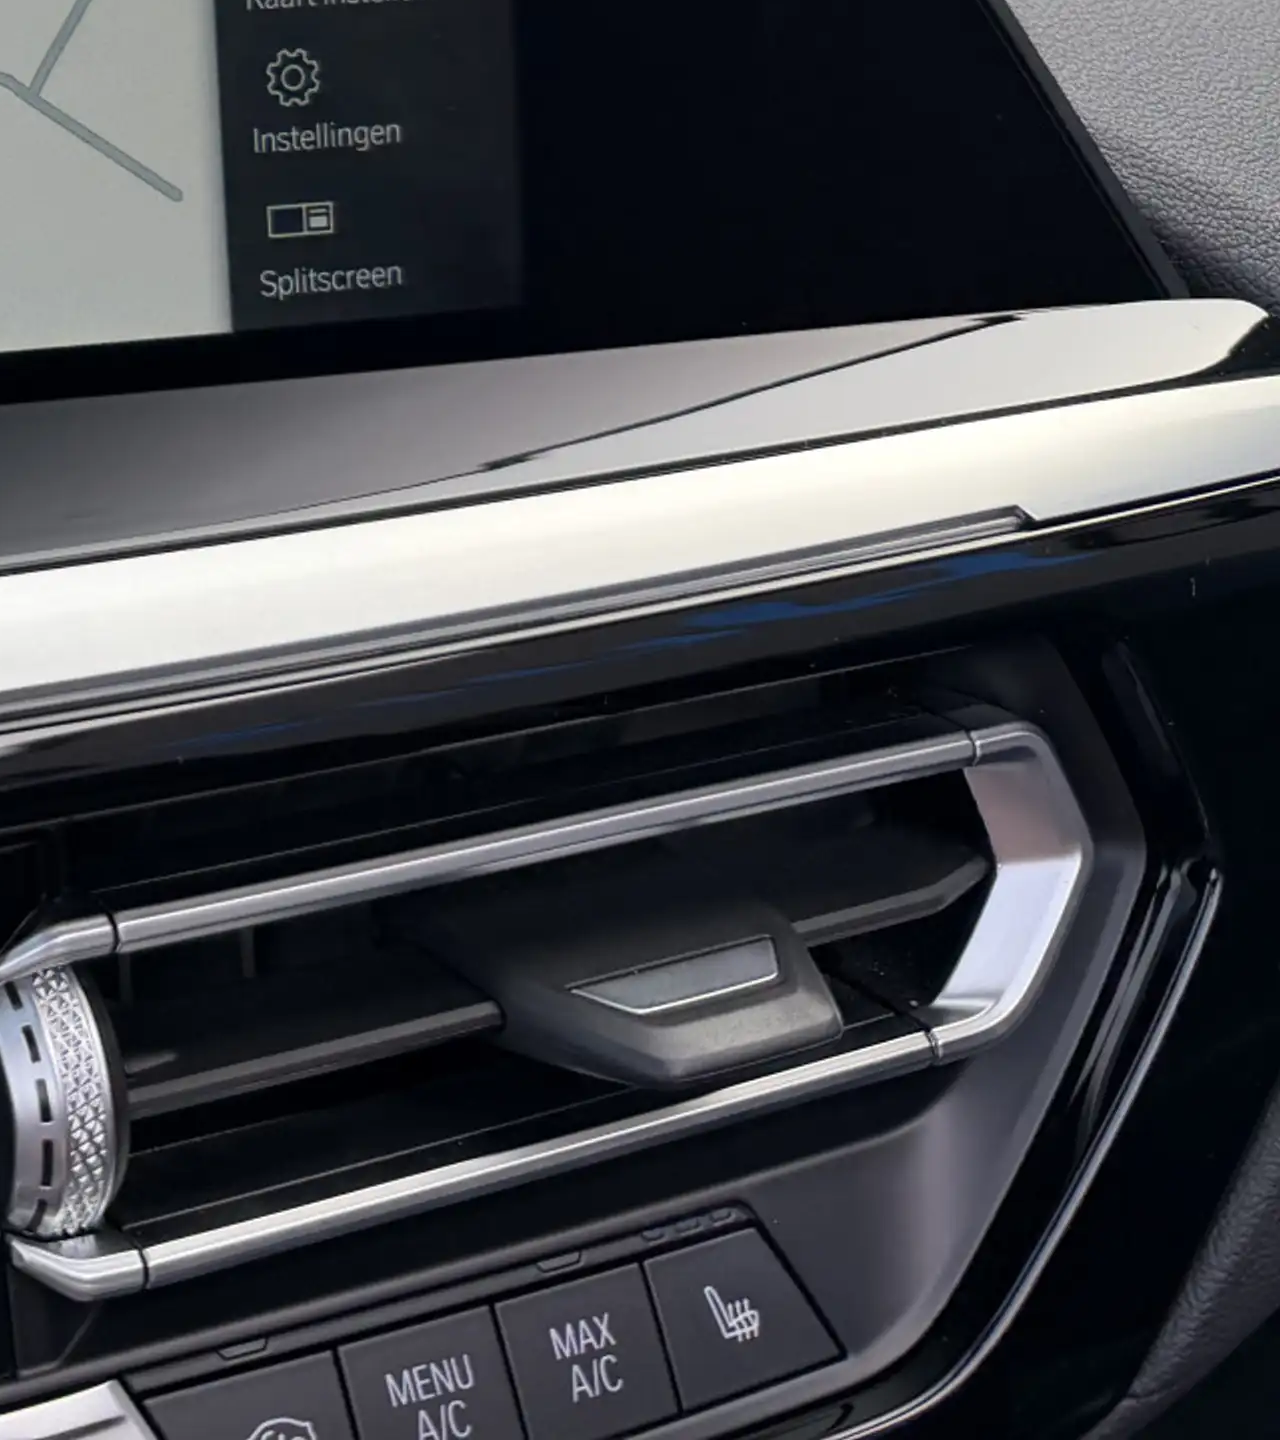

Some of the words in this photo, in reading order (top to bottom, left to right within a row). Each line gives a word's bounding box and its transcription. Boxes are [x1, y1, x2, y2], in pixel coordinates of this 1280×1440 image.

[252, 118, 402, 154] Instellingen
[259, 262, 403, 300] Splitscreen
[549, 1312, 616, 1361] MAX
[384, 1353, 476, 1408] MENU
[570, 1354, 624, 1403] A/C
[416, 1399, 473, 1440] A/C
